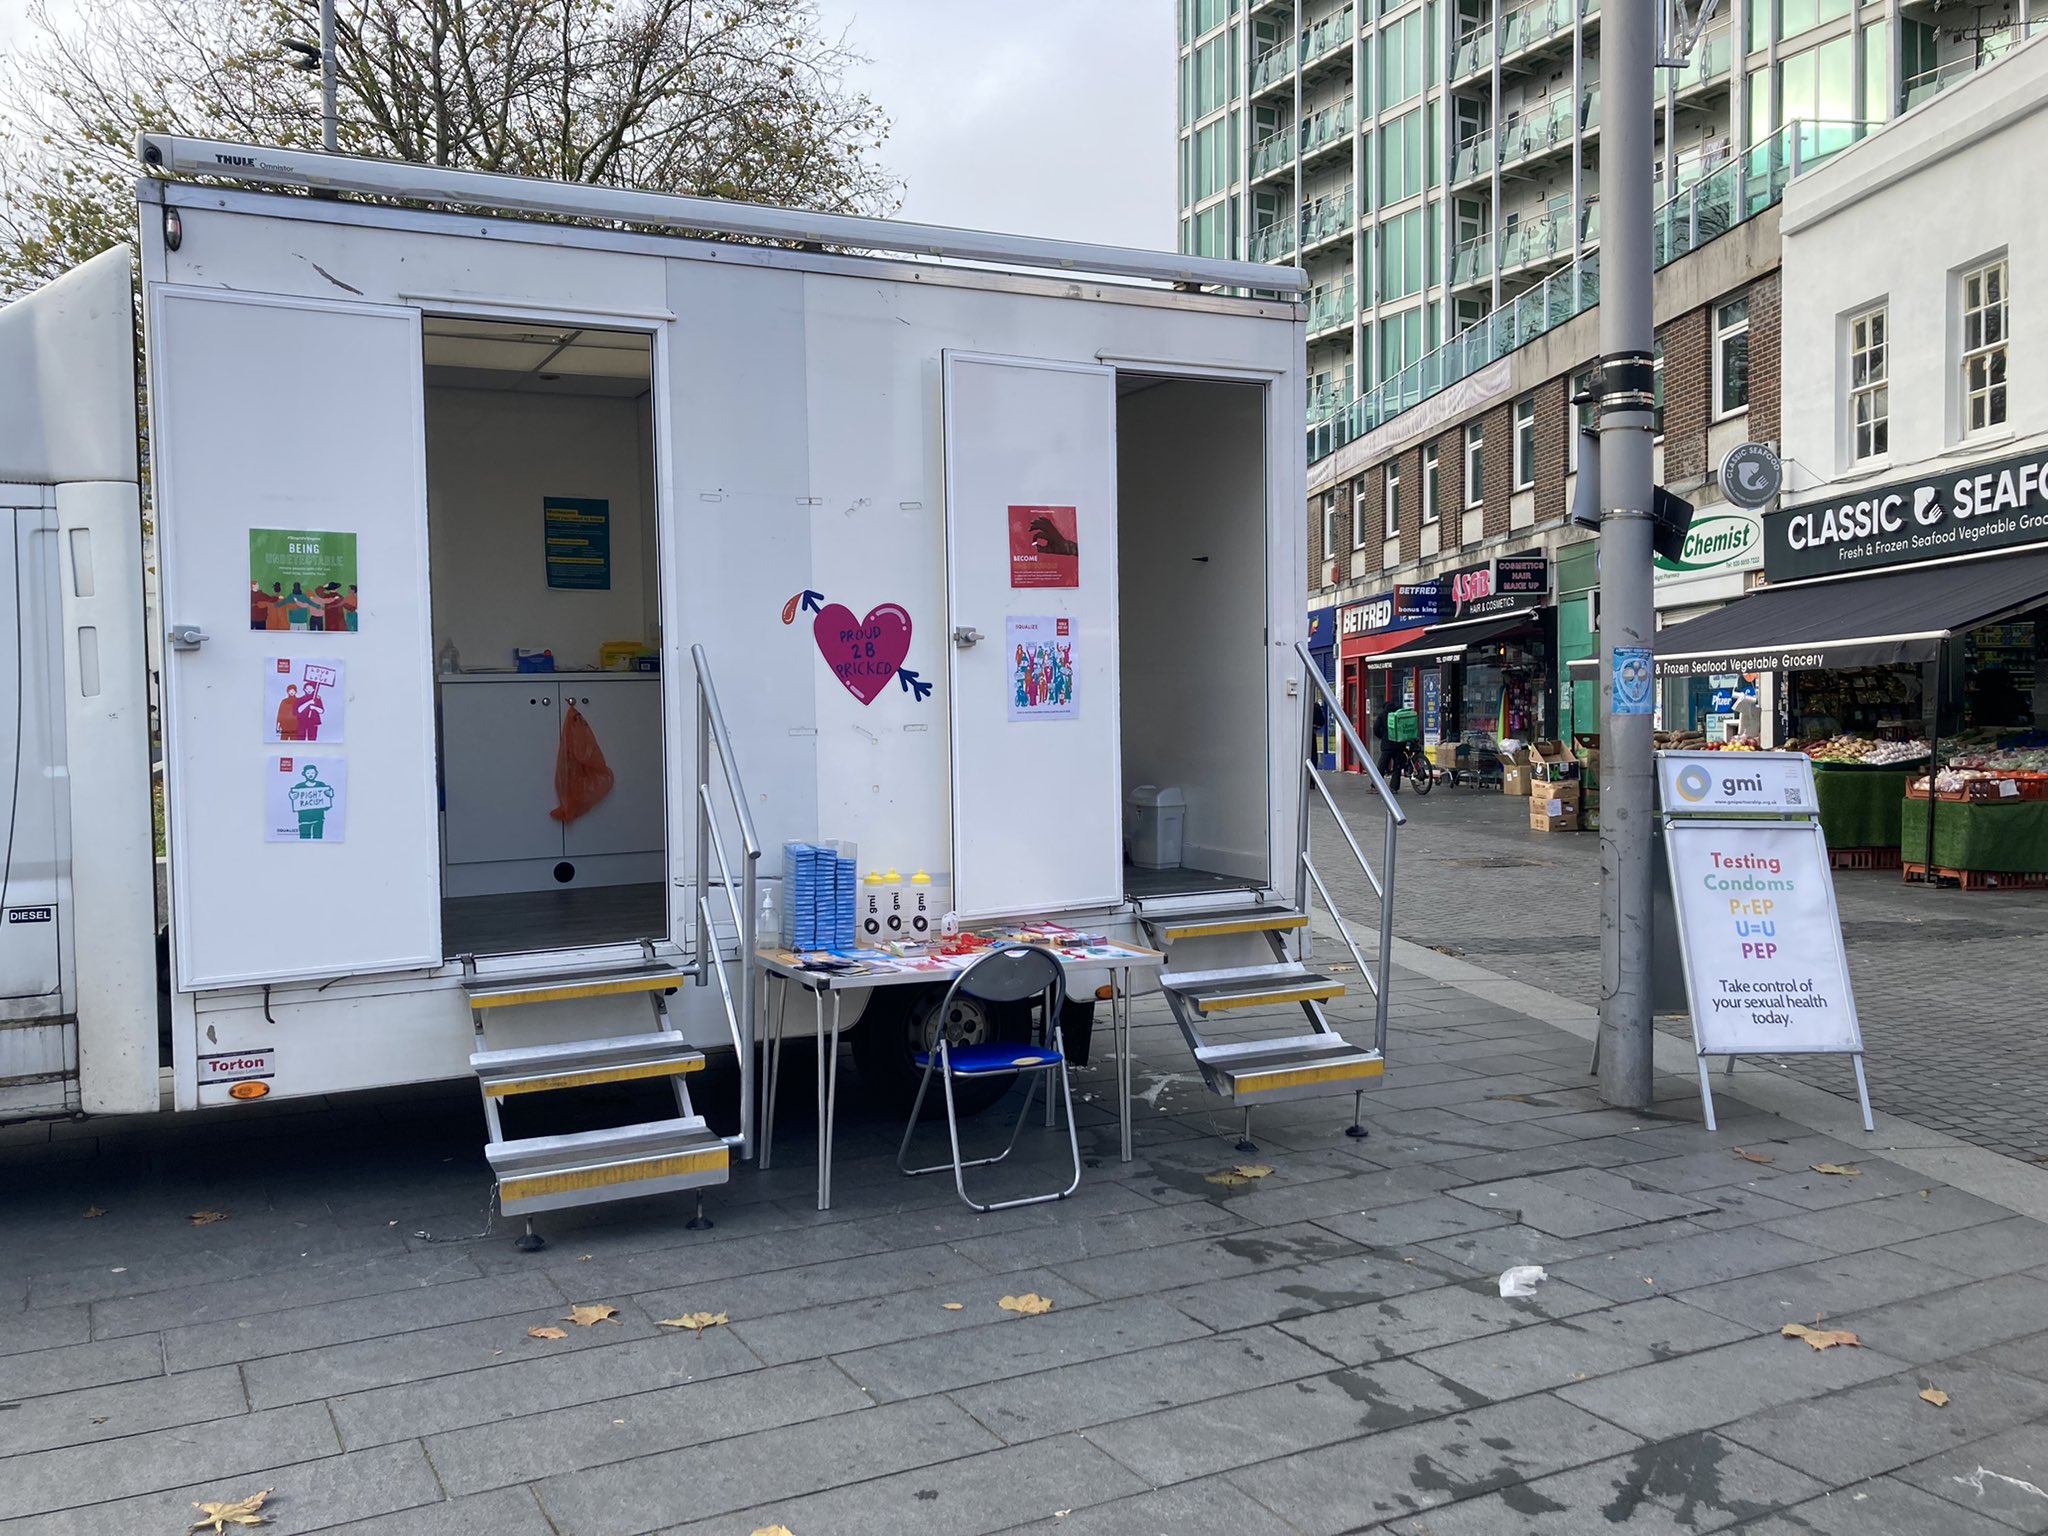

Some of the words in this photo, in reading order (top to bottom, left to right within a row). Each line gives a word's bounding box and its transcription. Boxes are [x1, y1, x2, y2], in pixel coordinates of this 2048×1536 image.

[215, 154, 255, 167] THULE
[260, 162, 294, 172] Omnistor
[1727, 450, 1746, 478] CLASSIC
[1749, 447, 1780, 470] SEAFOOD
[1788, 494, 1902, 550] CLASSIC
[1684, 523, 1750, 558] Chemist
[1840, 545, 1864, 560] Fresh
[1866, 544, 1873, 556] &
[1876, 540, 1908, 554] Frozen
[1912, 528, 1956, 548] Seafood
[1959, 518, 2016, 541] Vegetable
[289, 543, 320, 554] BEING
[1398, 586, 1437, 595] BETFRED
[1470, 603, 1481, 614] HAIR
[1482, 602, 1486, 612] &
[1486, 596, 1515, 611] COSMETICS
[1343, 600, 1392, 634] BETFRED
[840, 626, 880, 642] PROUD
[852, 644, 861, 659] 2
[865, 642, 875, 658] B
[836, 661, 892, 678] PRICKED
[1656, 664, 1661, 674] &
[1664, 662, 1689, 674] Frozen
[1692, 660, 1727, 673] Seafood
[1730, 656, 1778, 673] Vegetable
[1782, 654, 1824, 667] Grocery
[1712, 691, 1732, 711] Pfizer
[1722, 774, 1763, 796] gmi
[300, 799, 324, 807] RACISM
[1710, 852, 1781, 874] Testing
[1704, 874, 1794, 891] Condoms
[868, 894, 877, 914] gmi
[892, 892, 900, 911] gmi
[916, 892, 926, 912] gmi
[1729, 898, 1774, 915] PrEP
[11, 911, 50, 920] DIESEL
[1736, 921, 1776, 937] U=U
[1742, 943, 1777, 959] PEP
[1719, 979, 1750, 992] Take
[1752, 978, 1798, 992] control
[1800, 978, 1812, 992] of
[1712, 998, 1741, 1012] your
[1744, 994, 1785, 1008] sexual
[1786, 994, 1828, 1008] health
[1752, 1010, 1793, 1027] today.
[209, 1059, 264, 1072] Torton
